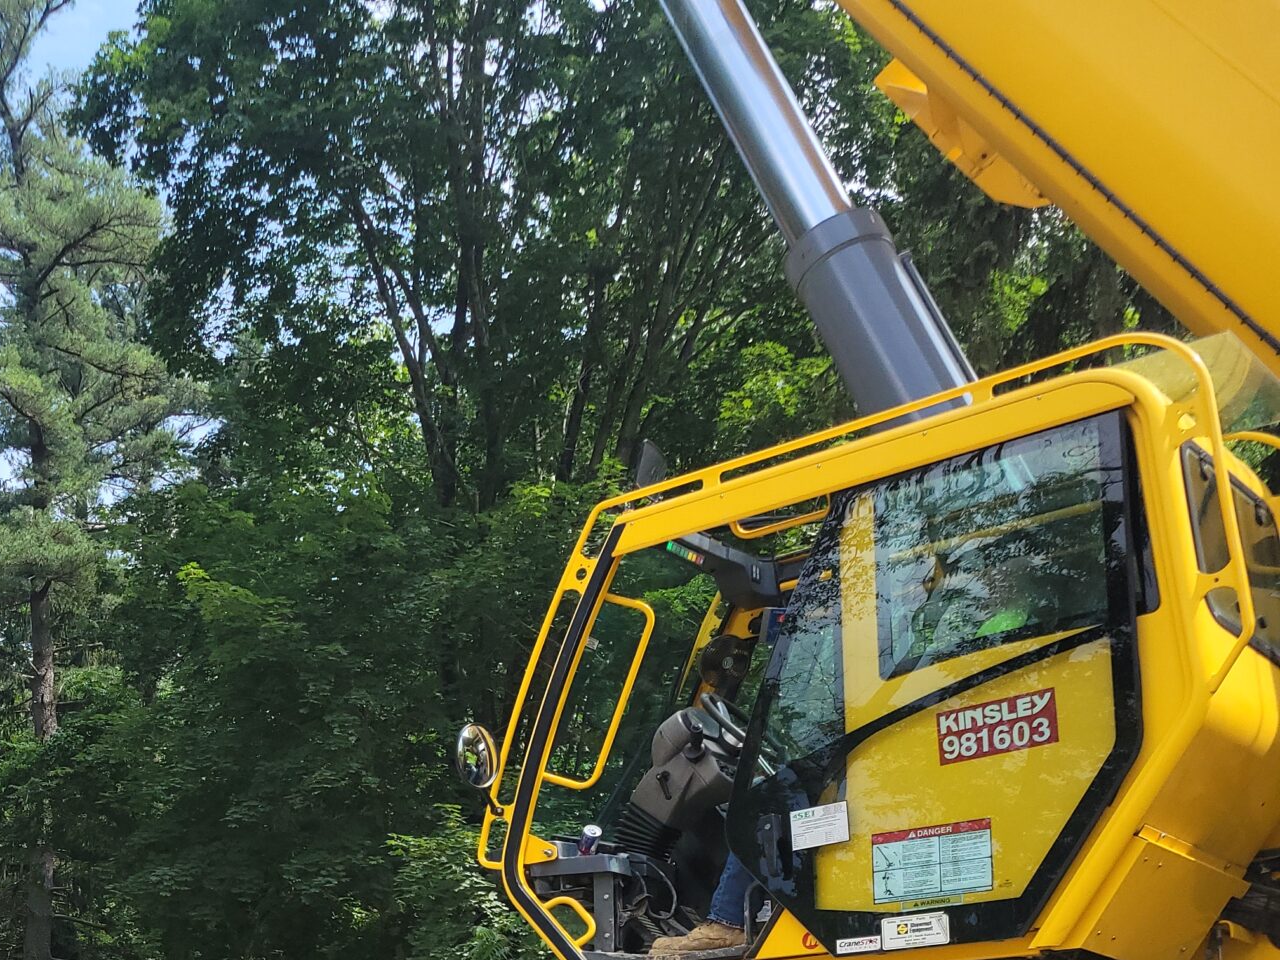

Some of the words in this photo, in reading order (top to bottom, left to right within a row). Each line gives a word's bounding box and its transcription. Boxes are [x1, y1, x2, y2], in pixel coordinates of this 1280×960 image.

[940, 692, 1051, 735] KINSLEY
[942, 717, 1051, 760] 981603
[917, 826, 952, 838] DANGER
[920, 898, 951, 906] WARNING
